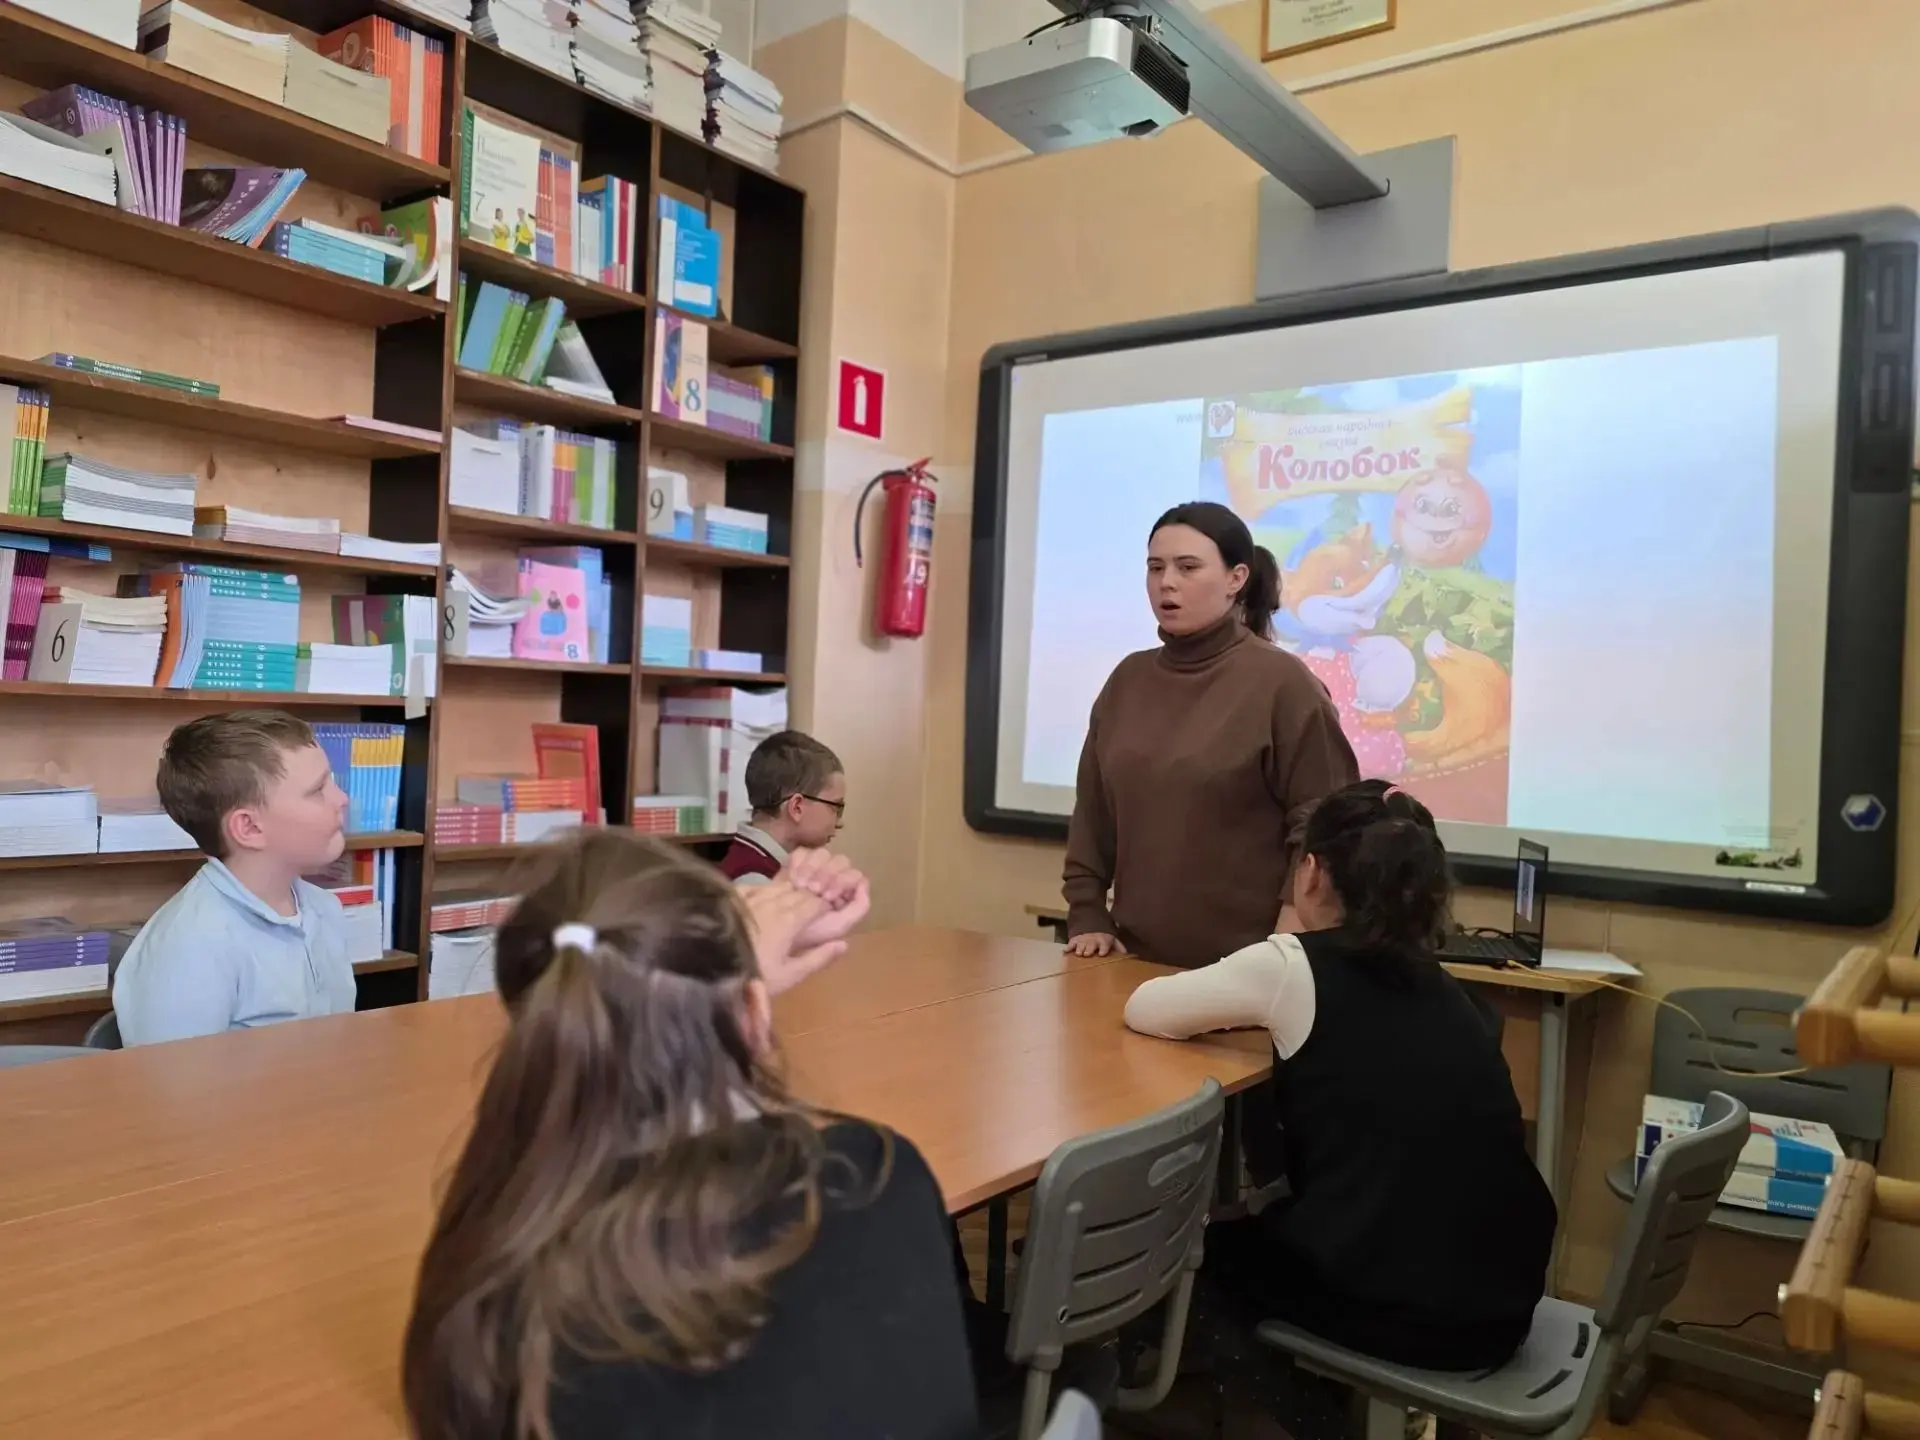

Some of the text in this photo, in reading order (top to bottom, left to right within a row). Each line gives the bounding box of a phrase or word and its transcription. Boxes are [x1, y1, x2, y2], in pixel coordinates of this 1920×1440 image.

[685, 378, 701, 412] 8
[1257, 444, 1421, 490] Колобок
[650, 488, 664, 520] 9
[52, 618, 69, 662] 6
[444, 605, 455, 641] 8
